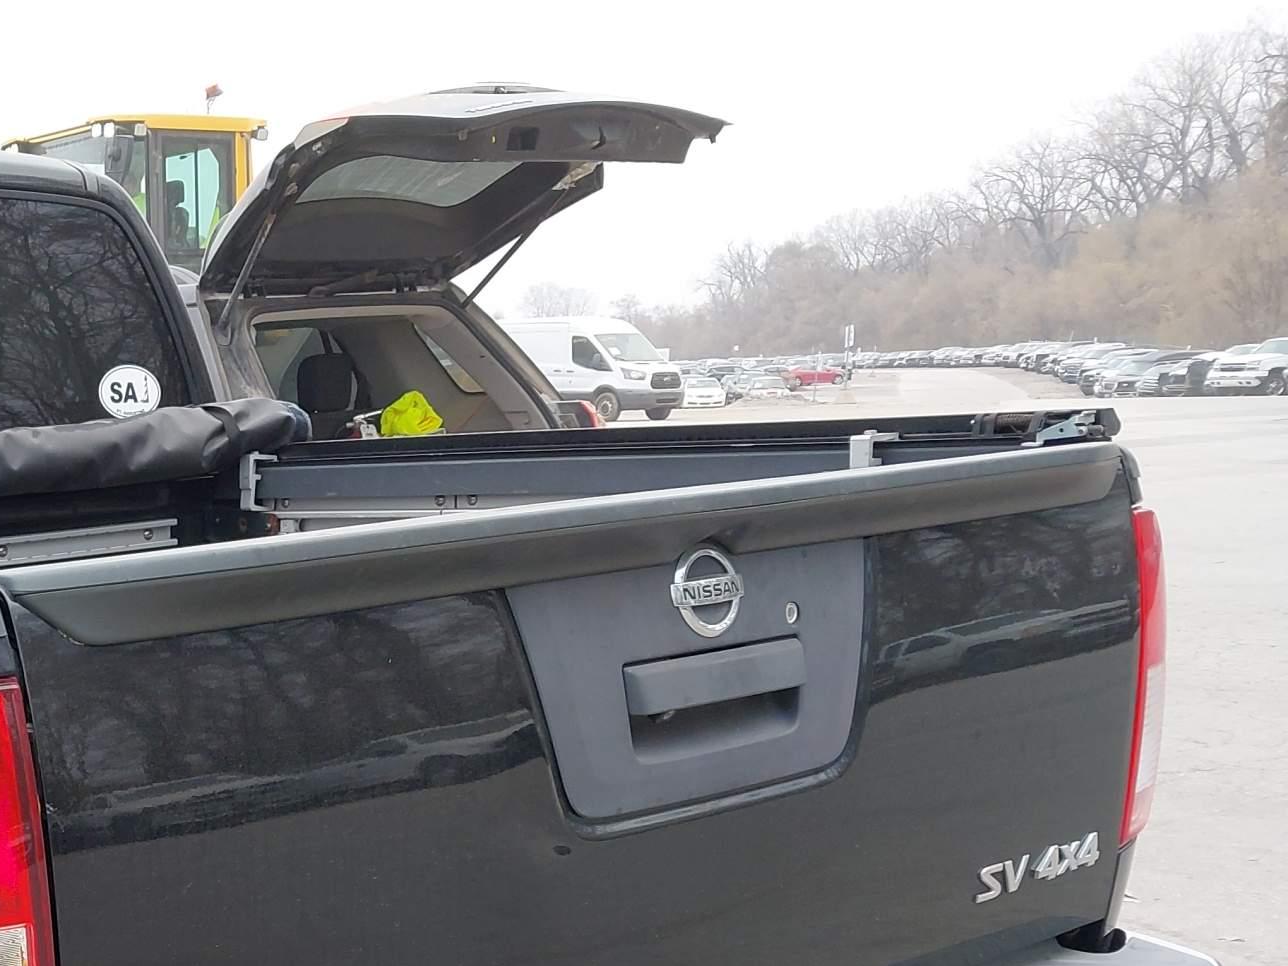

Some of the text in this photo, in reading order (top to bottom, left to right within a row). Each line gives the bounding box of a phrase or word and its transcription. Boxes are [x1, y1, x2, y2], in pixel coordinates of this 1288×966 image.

[110, 381, 138, 404] SA
[682, 580, 740, 601] NISSAN
[975, 853, 1030, 904] SV
